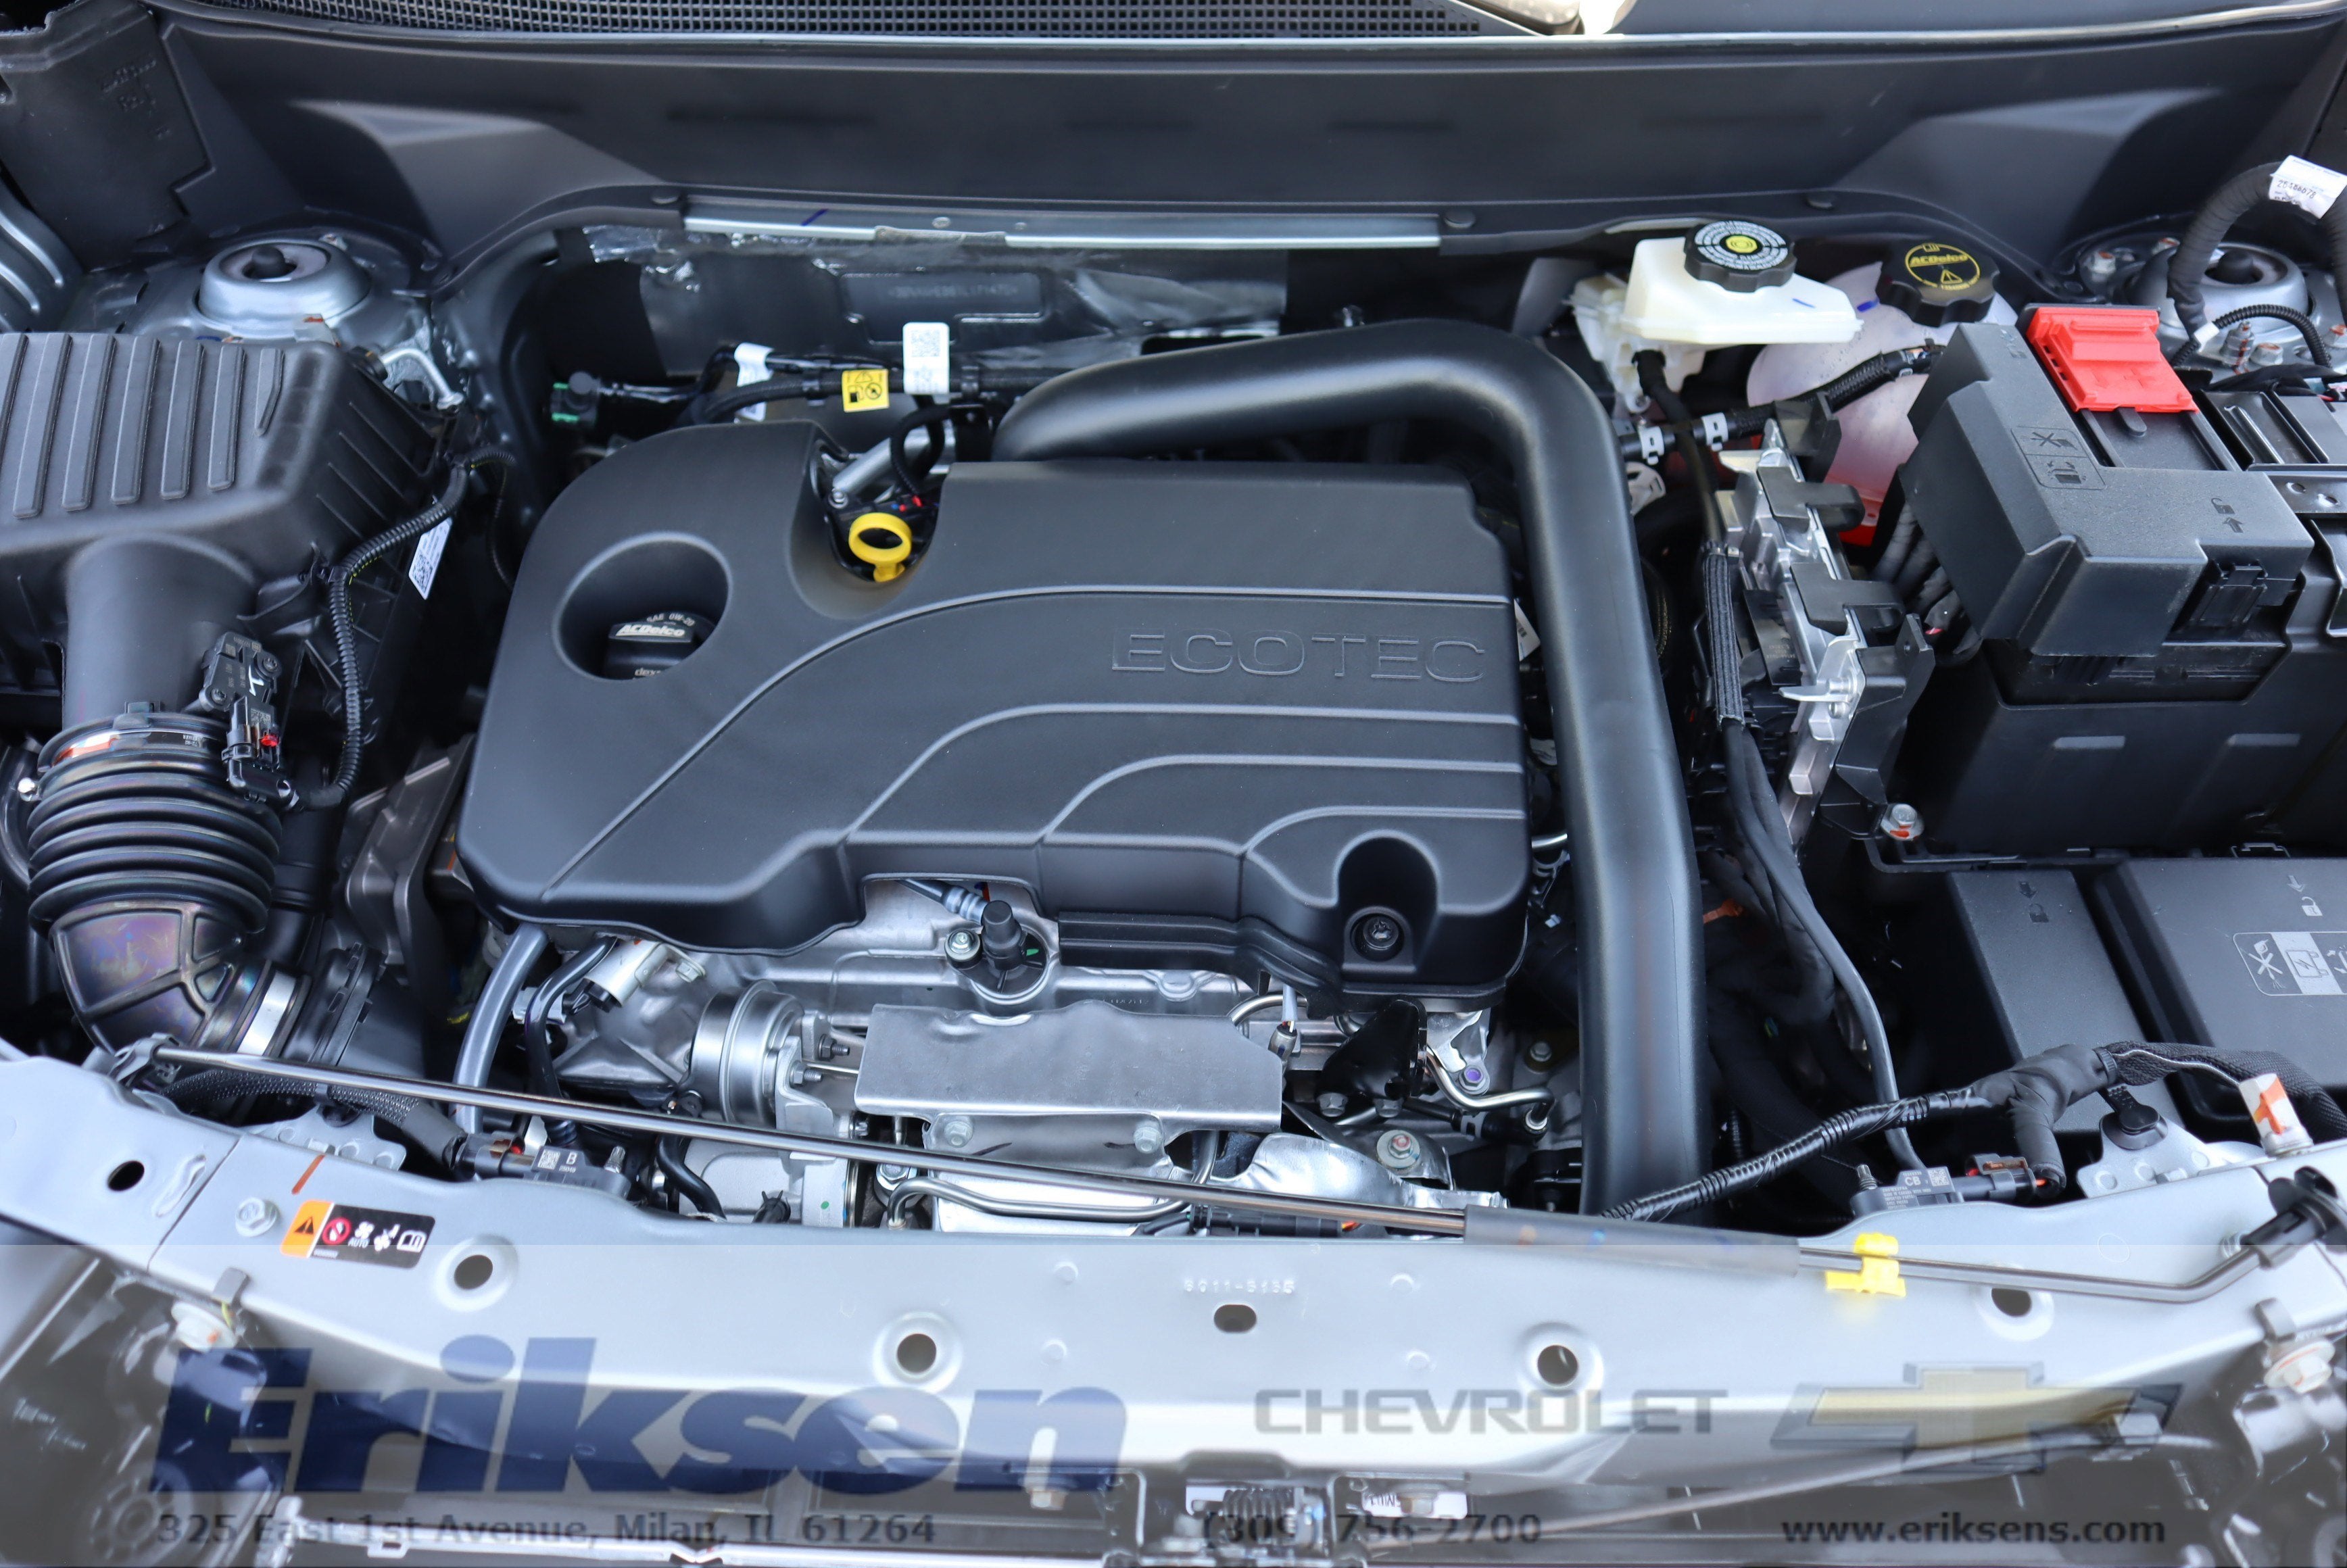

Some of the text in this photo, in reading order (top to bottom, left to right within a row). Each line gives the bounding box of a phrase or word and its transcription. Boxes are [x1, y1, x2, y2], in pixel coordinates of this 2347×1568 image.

[615, 624, 685, 637] ACDelco
[1113, 615, 1484, 681] ECOTEC
[566, 1152, 577, 1165] B
[1905, 1176, 1921, 1186] CB
[348, 1238, 370, 1249] AUTO
